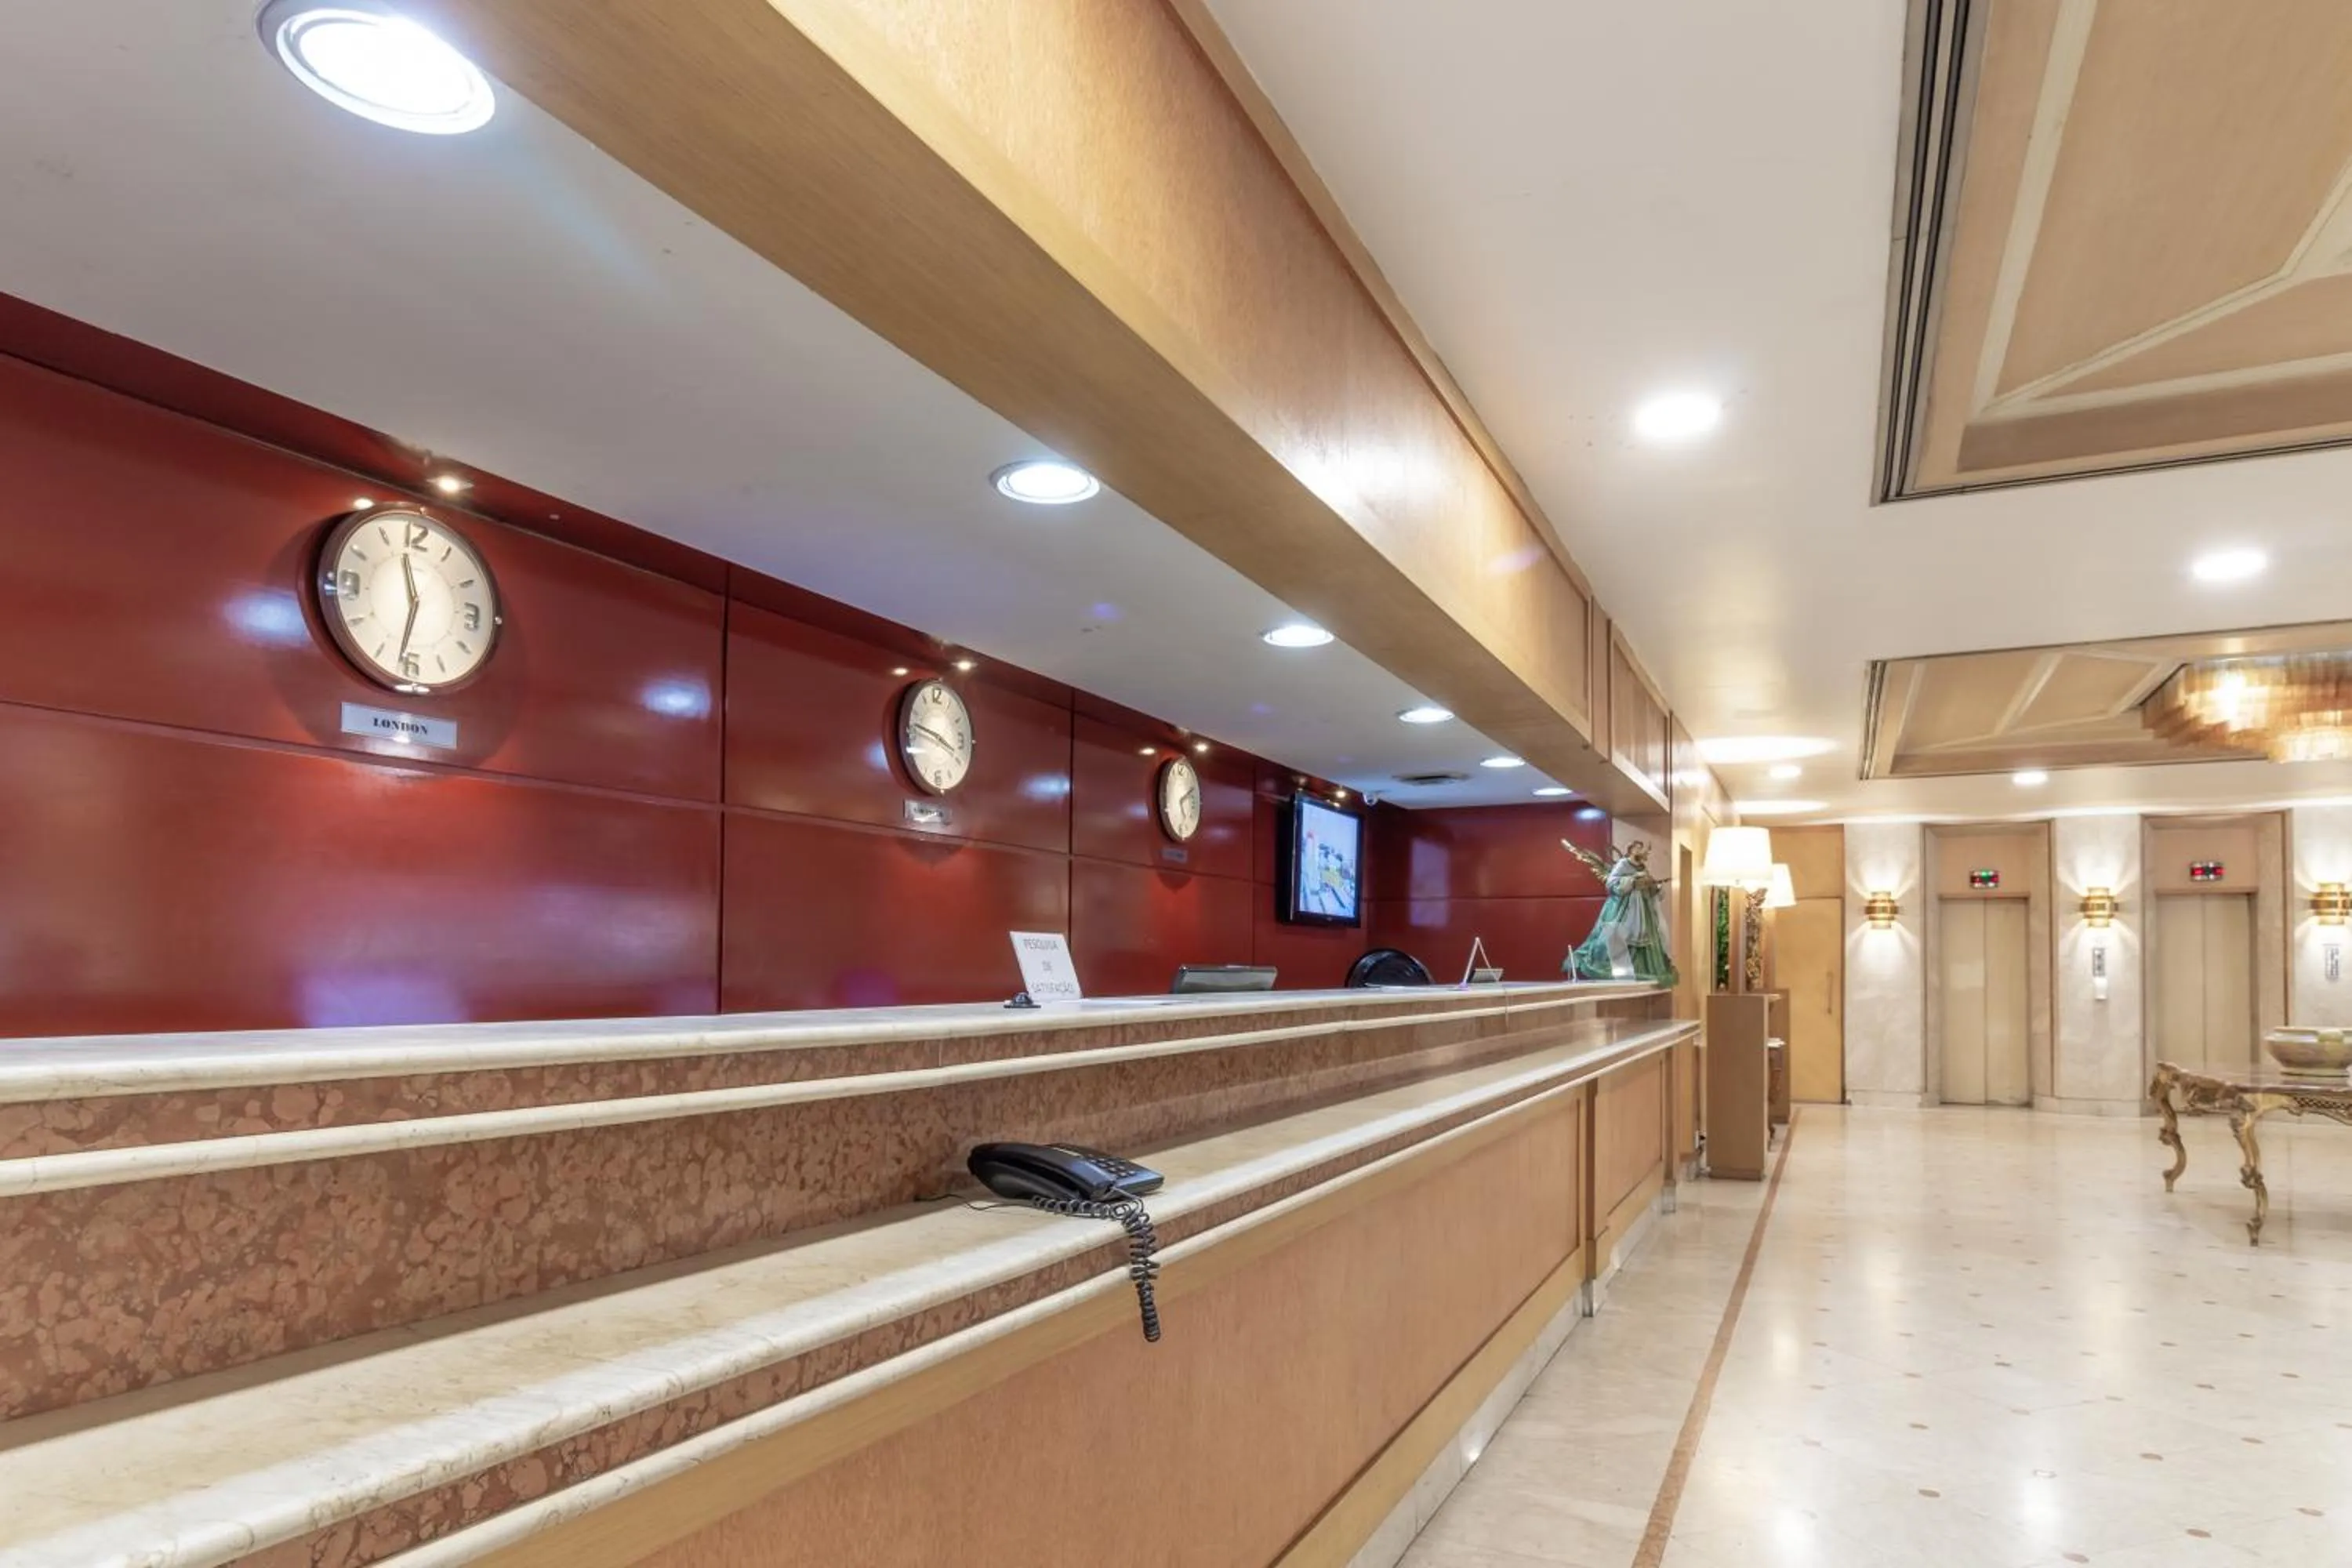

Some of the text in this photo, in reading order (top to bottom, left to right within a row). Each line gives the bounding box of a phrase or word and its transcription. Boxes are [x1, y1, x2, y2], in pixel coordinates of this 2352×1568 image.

[404, 522, 428, 552] 12
[340, 569, 360, 601] 9
[463, 602, 479, 632] 3
[402, 653, 419, 678] 6
[931, 687, 942, 705] 12
[372, 717, 429, 735] LONDON
